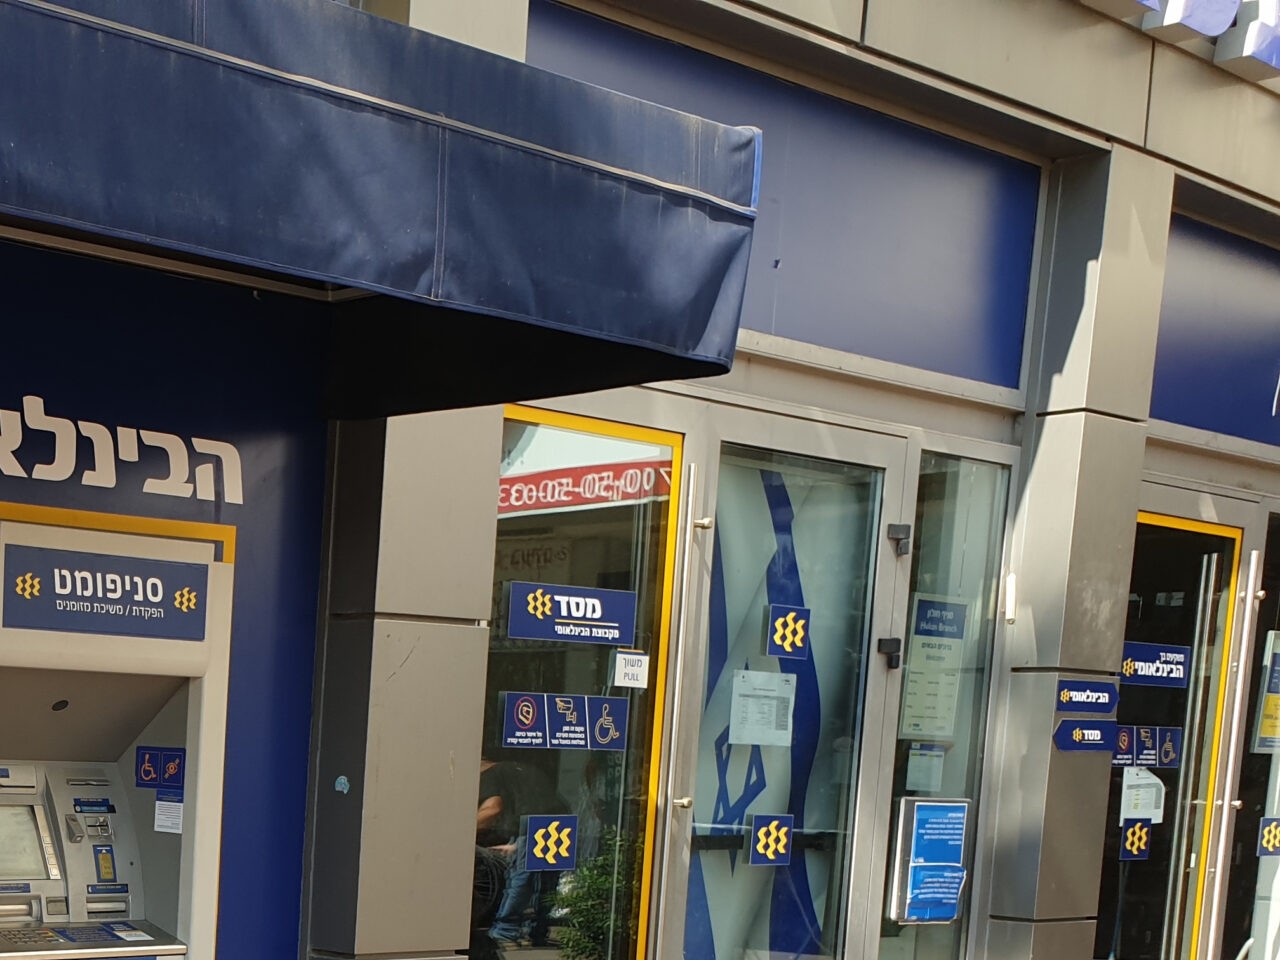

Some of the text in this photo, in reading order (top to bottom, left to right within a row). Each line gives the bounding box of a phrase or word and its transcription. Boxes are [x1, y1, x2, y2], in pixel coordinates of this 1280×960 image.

[53, 568, 163, 603] סניפומט
[56, 600, 91, 612] מזומנים
[93, 603, 123, 615] משיכת
[132, 606, 164, 619] הפקדת
[553, 595, 602, 619] מסד
[554, 624, 619, 640] מקבוצת הבינלאומי
[623, 657, 642, 669] משוך
[1134, 660, 1184, 678] הבינלאומי
[623, 672, 639, 682] PULL
[1070, 689, 1109, 703] הבינלאומי
[1082, 730, 1101, 740] מסד
